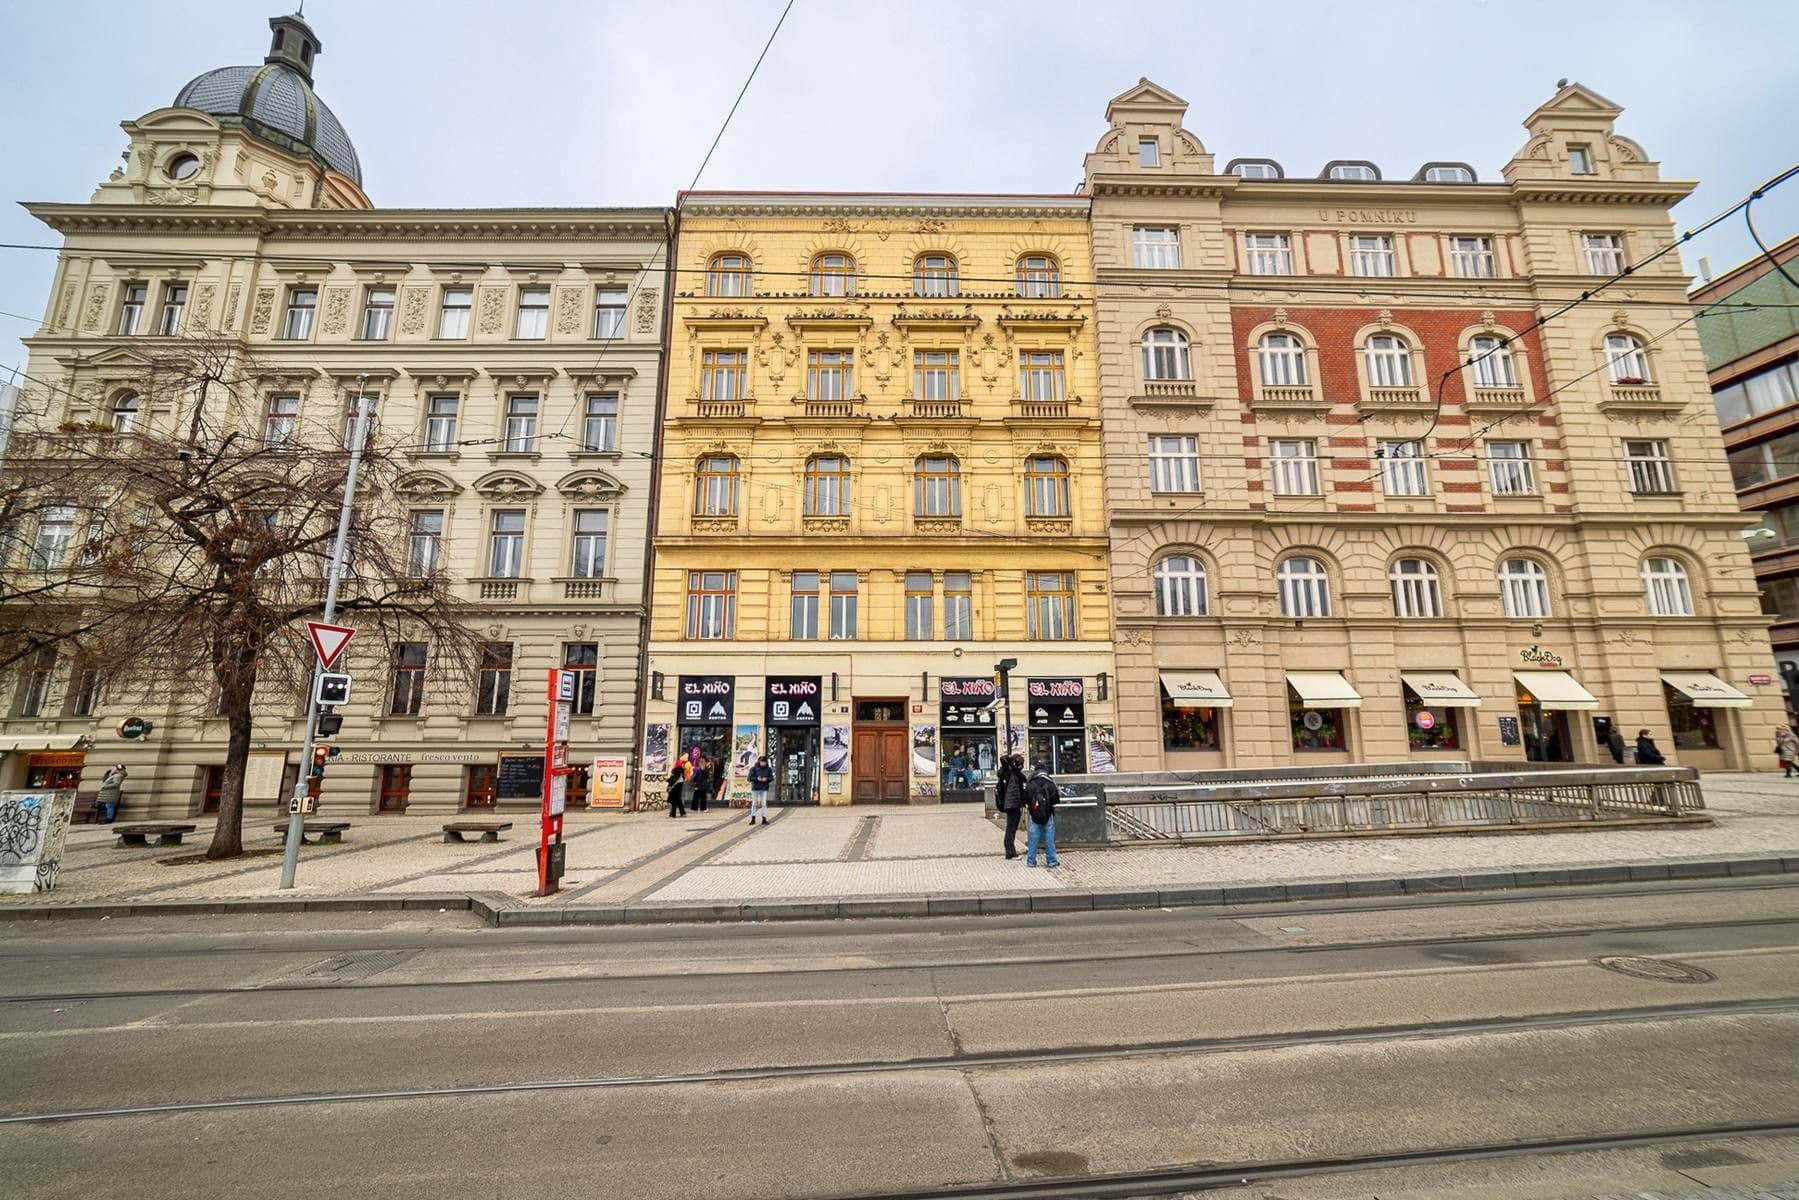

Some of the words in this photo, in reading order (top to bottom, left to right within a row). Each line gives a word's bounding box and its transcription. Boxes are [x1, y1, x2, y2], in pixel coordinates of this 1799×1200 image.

[1319, 210, 1328, 221] U
[685, 683, 700, 694] EL
[771, 683, 787, 694] EL
[942, 681, 961, 695] EL
[1029, 682, 1048, 696] EL
[351, 753, 412, 762] RISTORANTE
